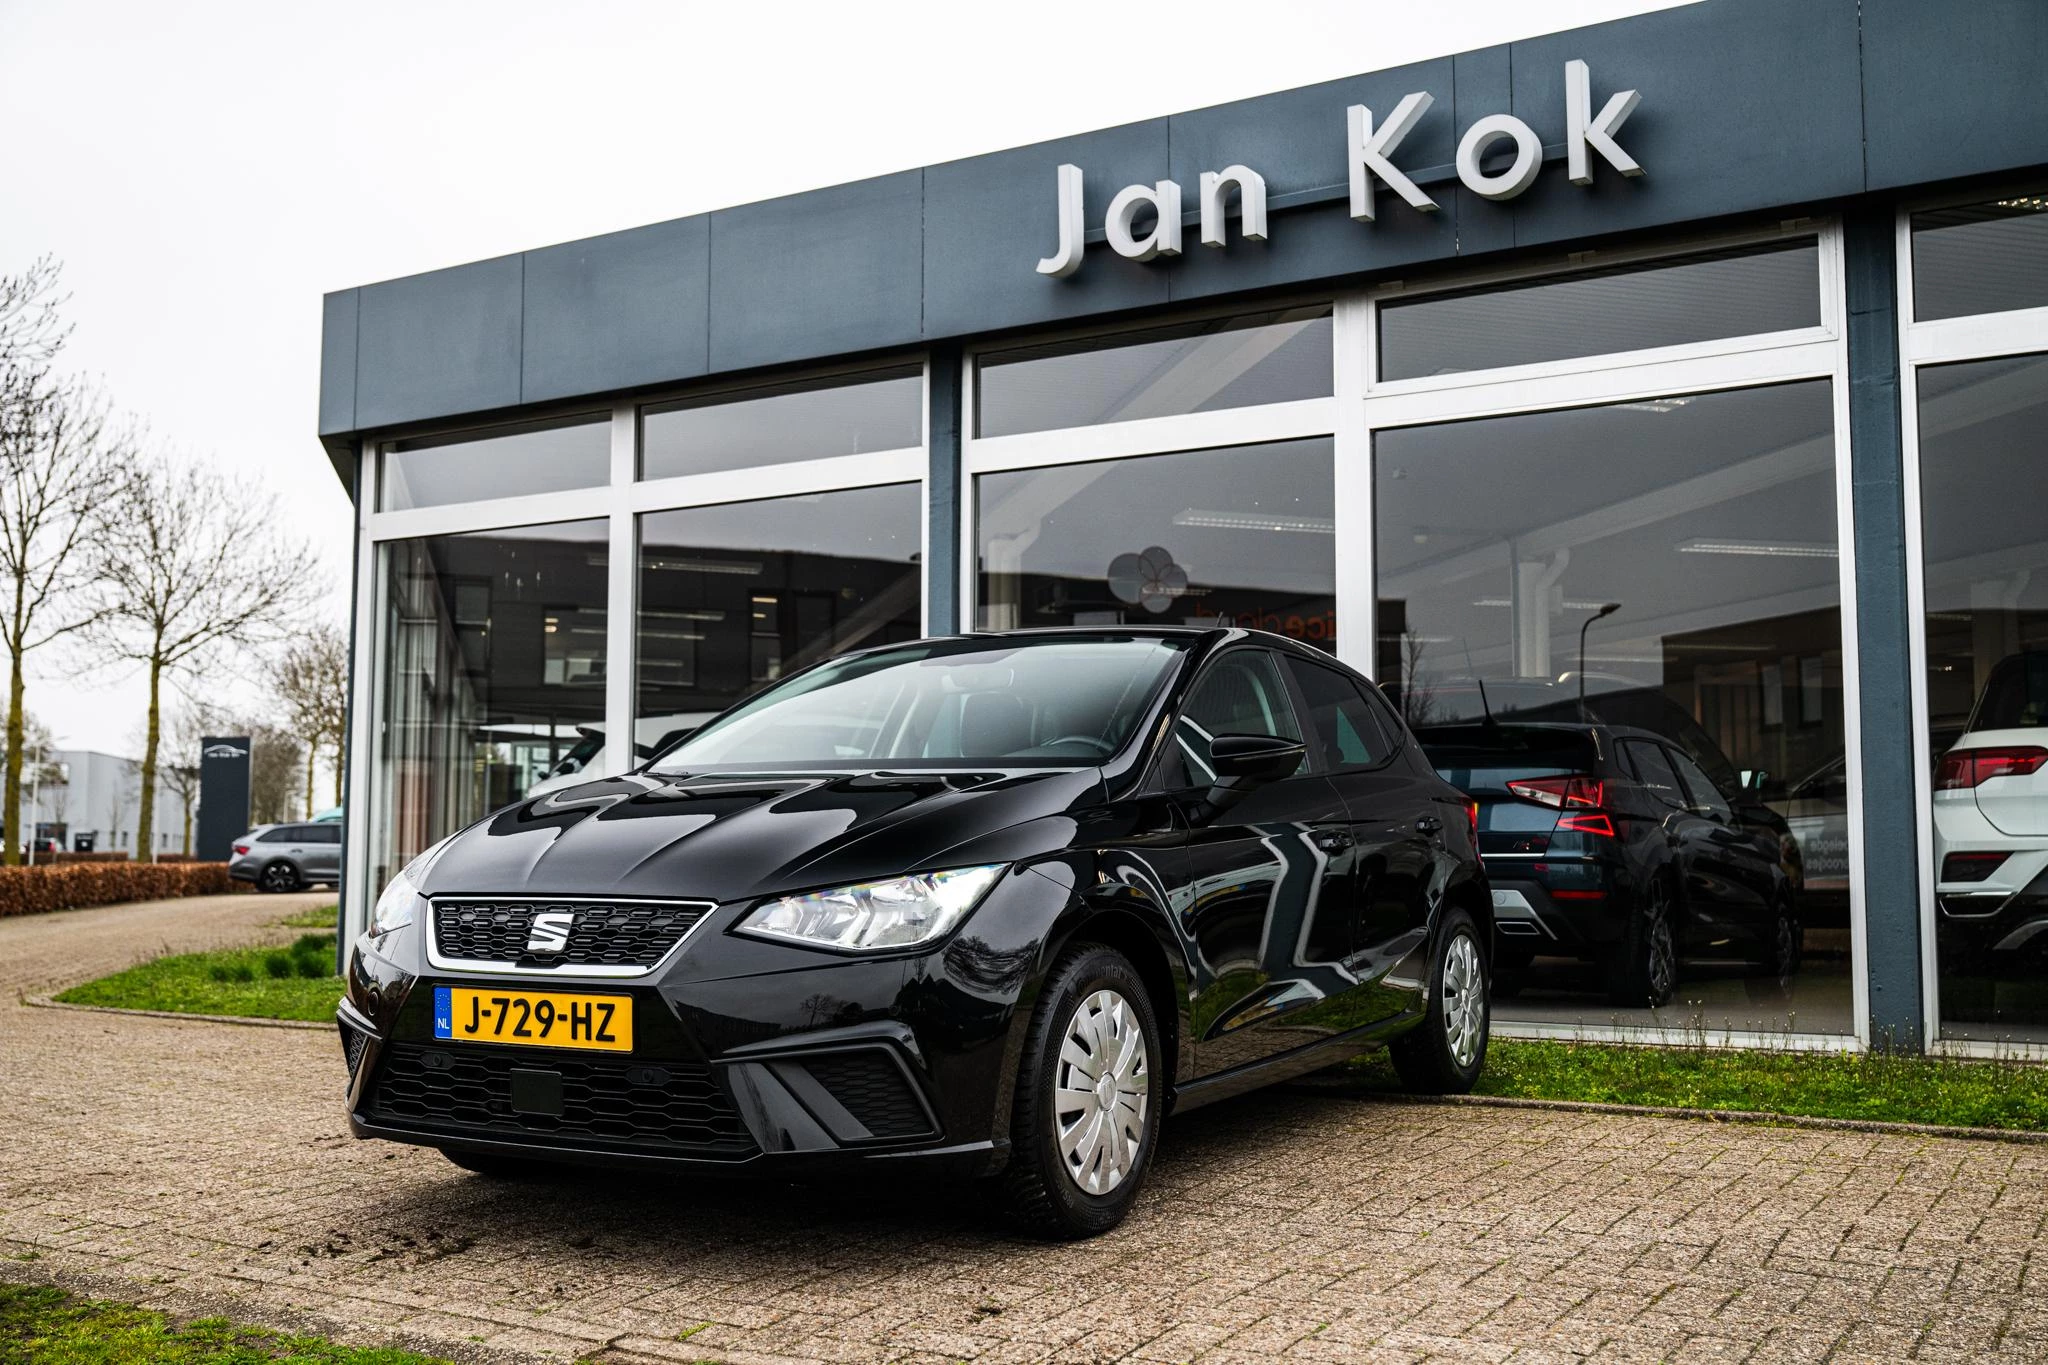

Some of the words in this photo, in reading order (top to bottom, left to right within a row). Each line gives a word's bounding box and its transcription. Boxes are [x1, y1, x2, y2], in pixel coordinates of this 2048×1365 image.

[1036, 163, 1268, 278] Jan
[1347, 59, 1647, 222] Kok
[437, 1017, 450, 1030] NL
[465, 996, 617, 1043] J-729-HZ
